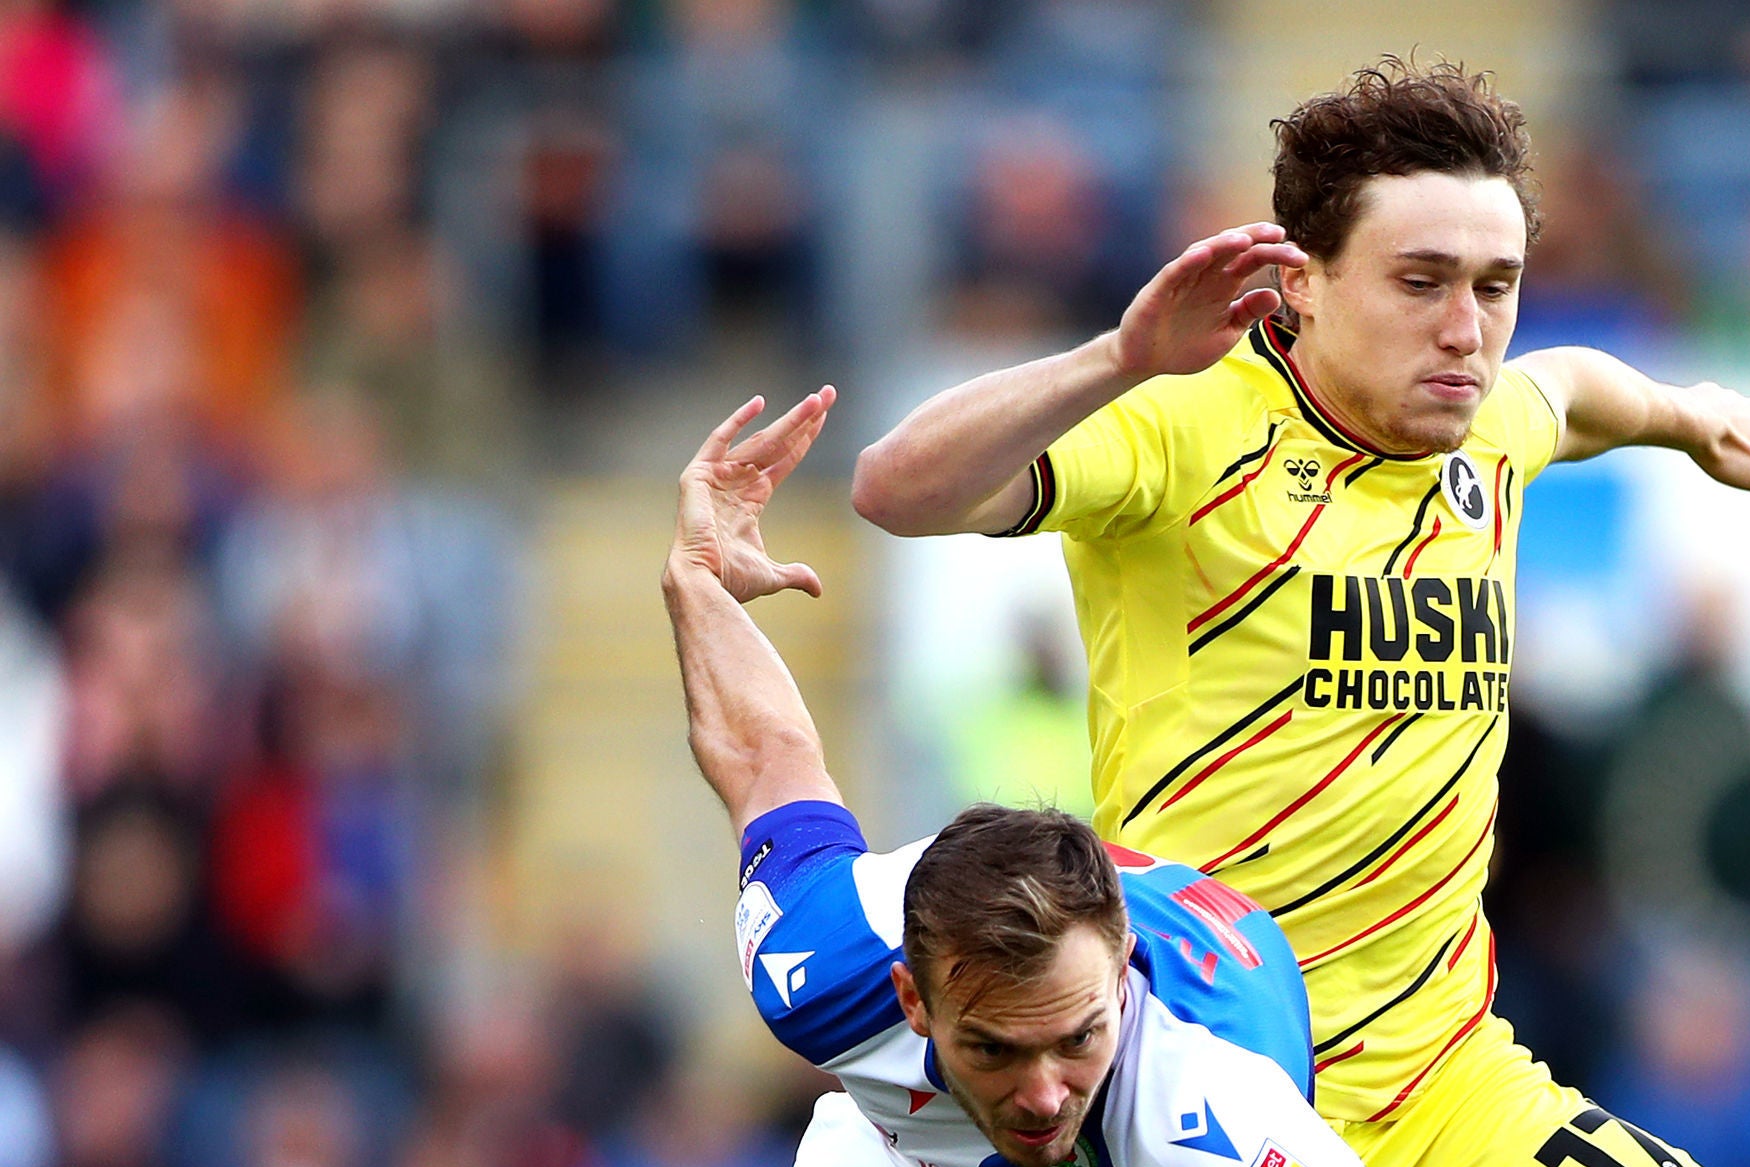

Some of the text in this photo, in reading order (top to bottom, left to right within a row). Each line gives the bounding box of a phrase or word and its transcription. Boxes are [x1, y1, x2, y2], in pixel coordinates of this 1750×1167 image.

[1288, 491, 1332, 503] hummel
[1309, 575, 1509, 664] HUSKI
[1304, 668, 1507, 712] CHOCOLATE
